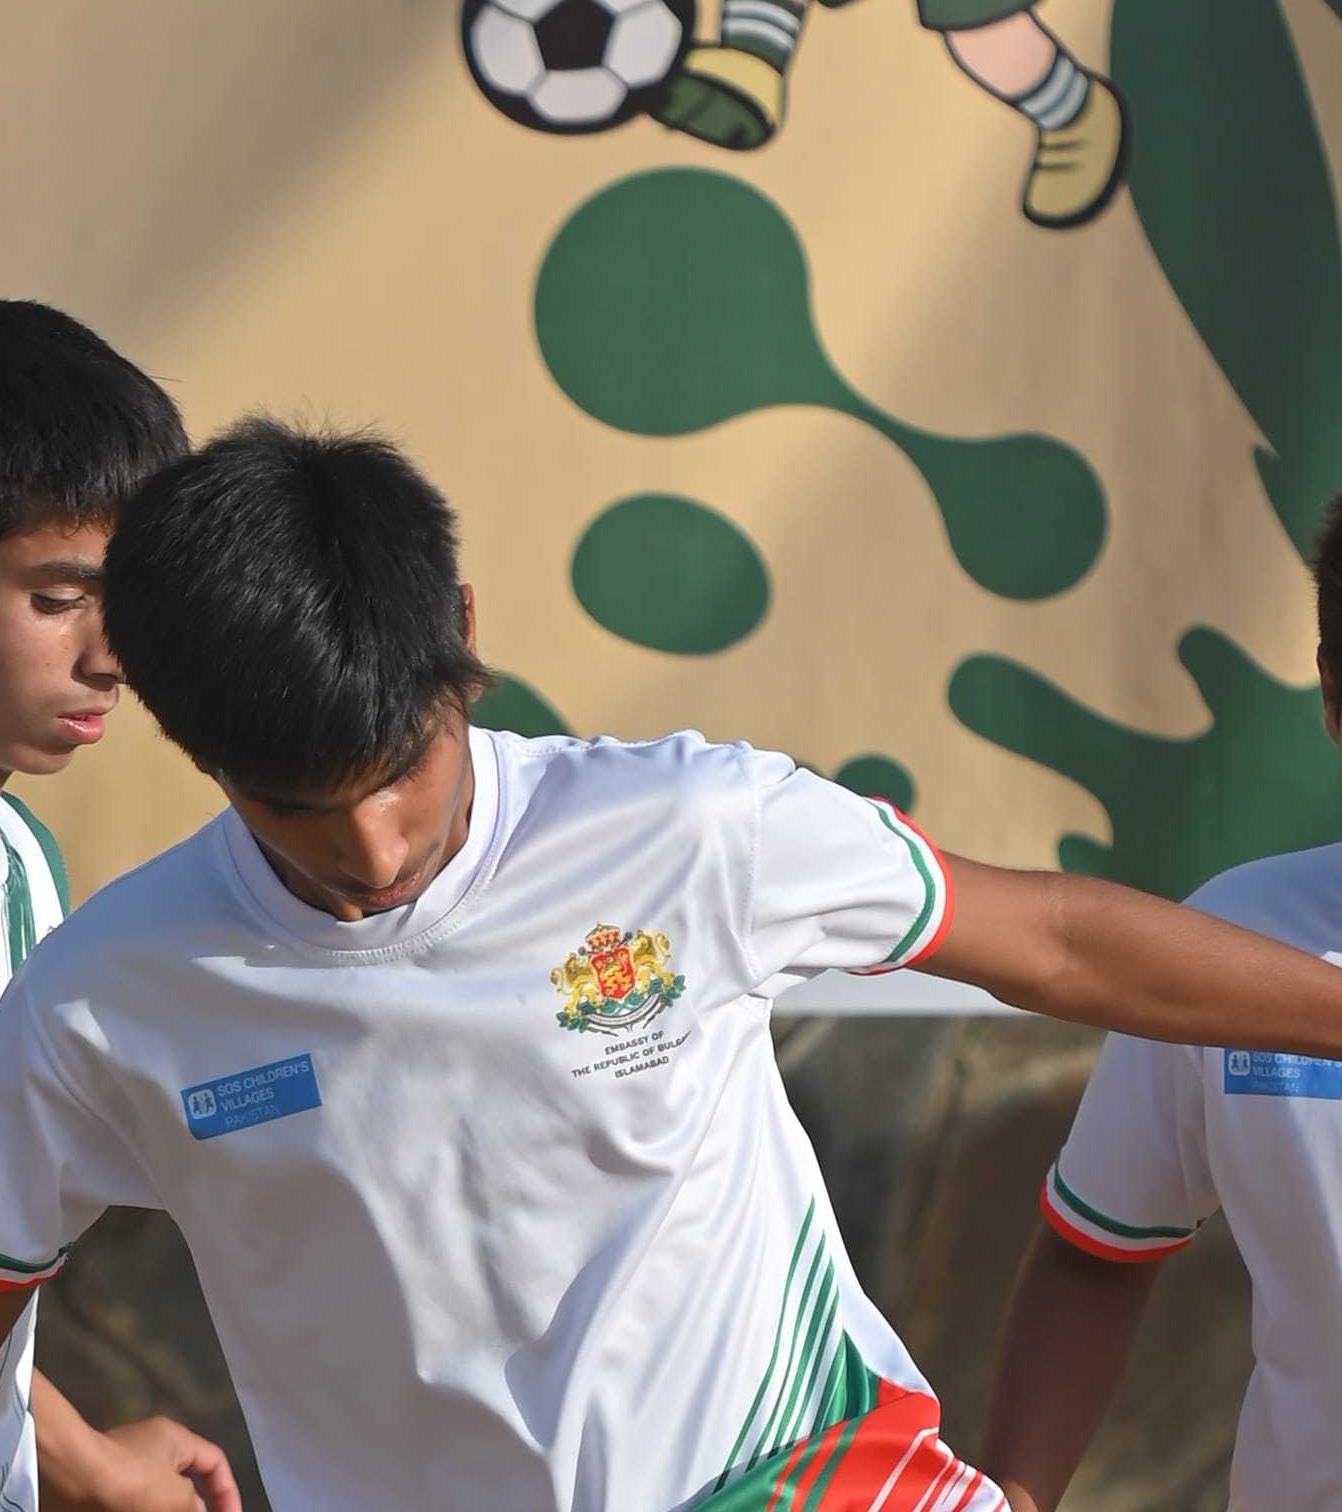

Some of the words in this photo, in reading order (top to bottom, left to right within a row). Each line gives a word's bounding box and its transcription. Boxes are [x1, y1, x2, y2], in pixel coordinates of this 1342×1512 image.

[604, 1035, 650, 1055] EMBASSY
[651, 1030, 665, 1041] OF
[571, 1065, 592, 1078] THE
[593, 1051, 641, 1072] REPUBLIC
[642, 1046, 656, 1057] OF
[614, 1055, 670, 1079] ISLAMABAD
[217, 1081, 242, 1097] SOS
[243, 1060, 310, 1089] CHILDREN'S
[220, 1087, 275, 1112] VILLAGES
